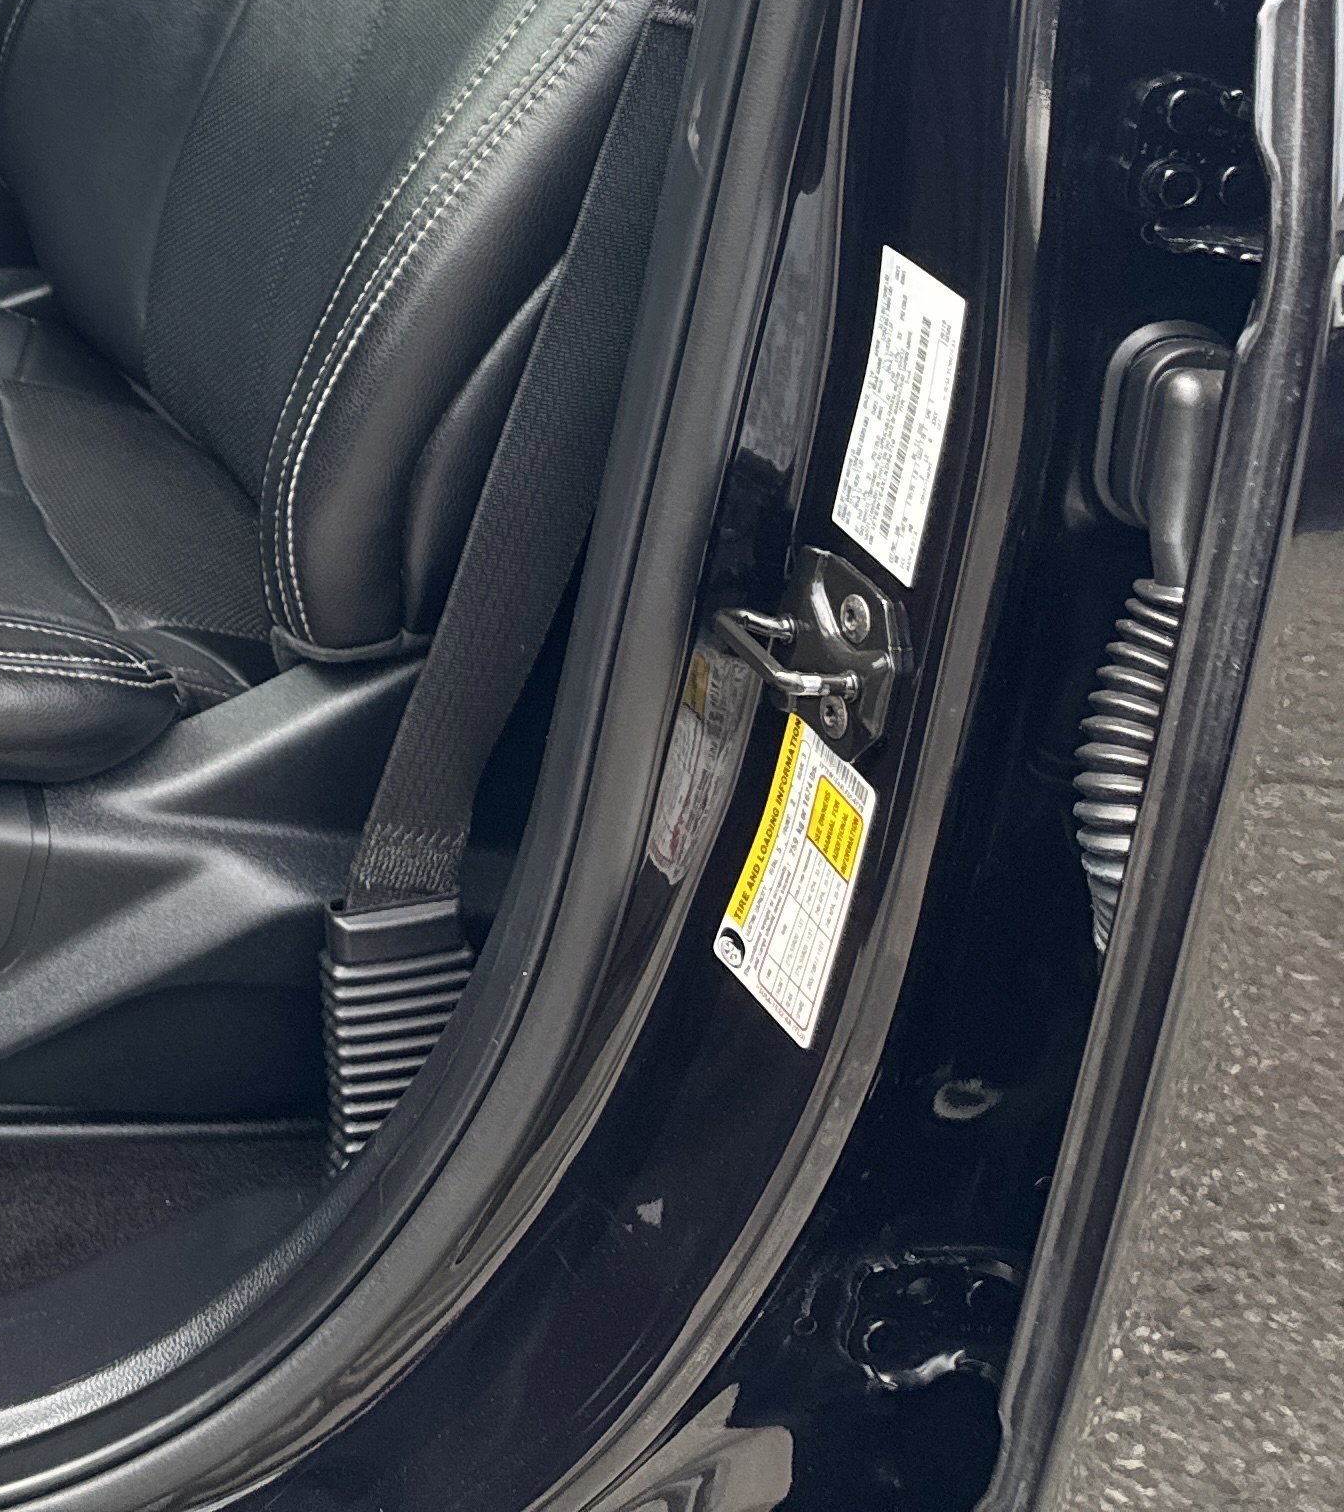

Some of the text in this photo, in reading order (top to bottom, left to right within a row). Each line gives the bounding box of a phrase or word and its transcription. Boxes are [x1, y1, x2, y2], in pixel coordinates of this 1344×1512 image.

[734, 891, 750, 920] TIRE
[747, 864, 760, 891] AND
[757, 807, 779, 863] LOADING
[776, 718, 802, 806] INFORMATION
